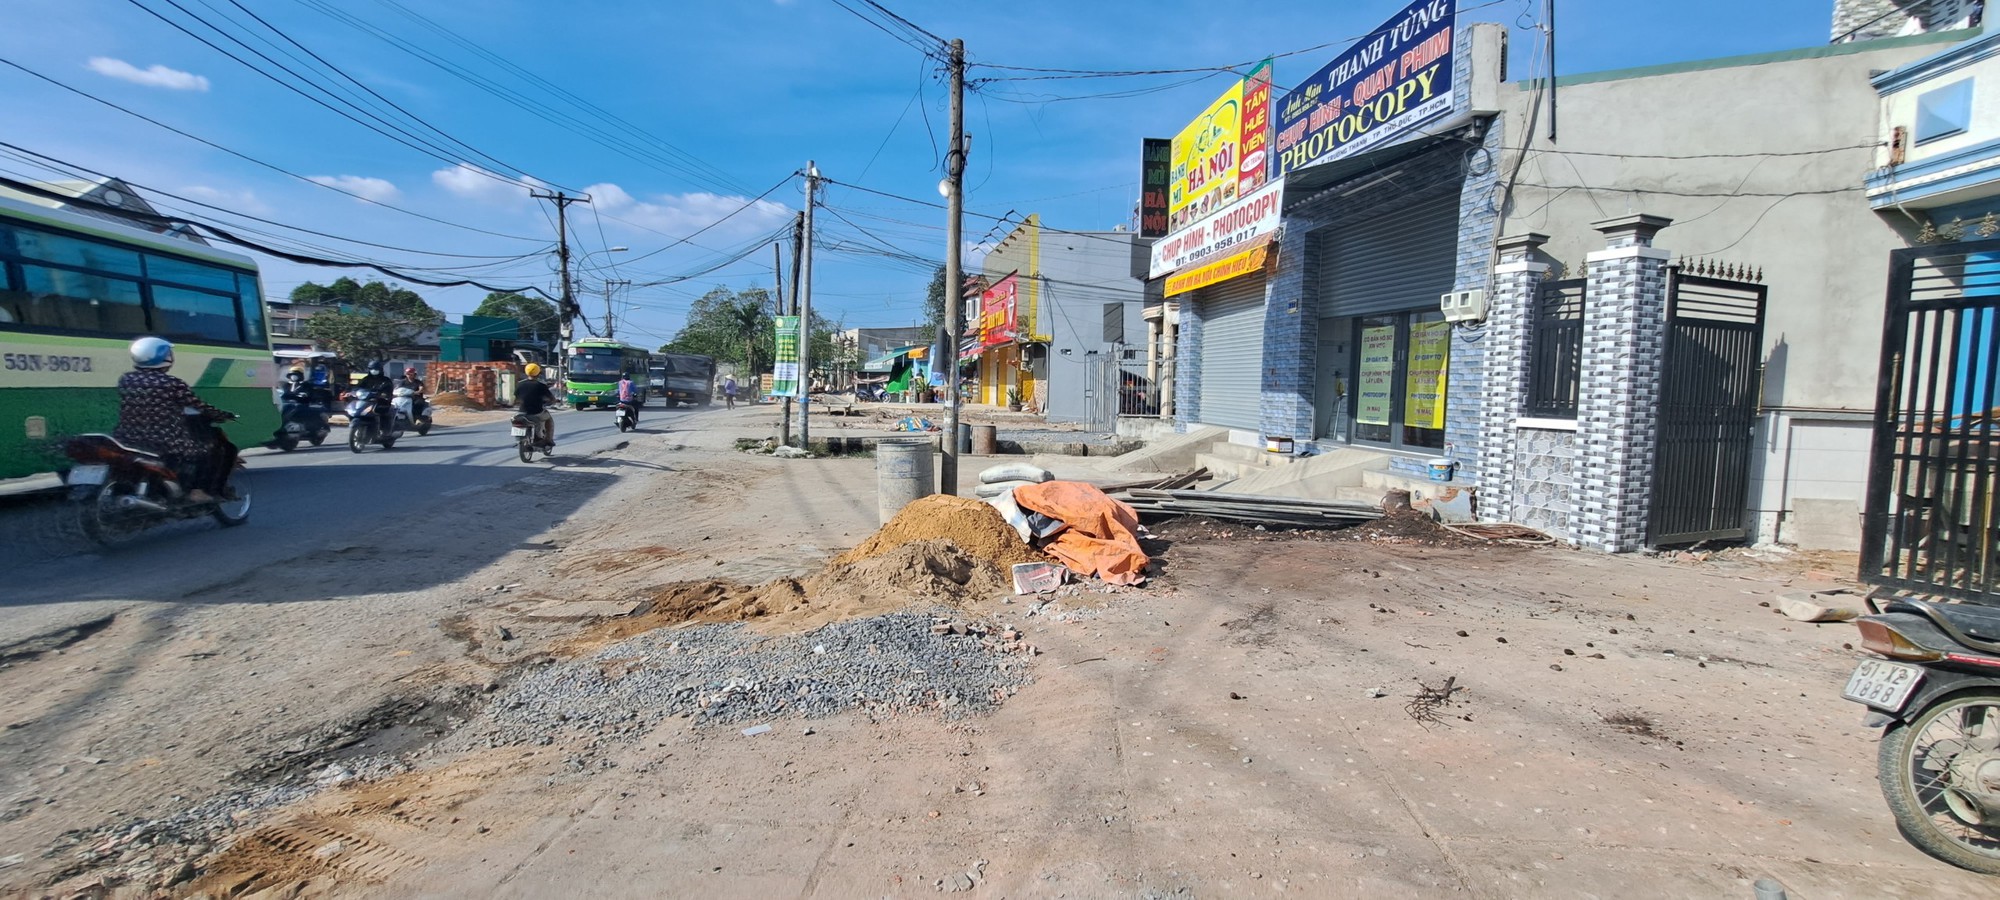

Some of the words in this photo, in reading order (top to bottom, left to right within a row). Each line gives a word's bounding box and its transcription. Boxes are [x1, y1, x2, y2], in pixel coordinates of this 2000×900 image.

[1328, 34, 1387, 93] THANH
[1390, 0, 1448, 51] TÙNG
[1309, 94, 1342, 134] HÌNH
[1353, 59, 1397, 106] QUAY
[1400, 26, 1450, 79] PHIM
[1245, 87, 1267, 114] TÂN
[1419, 98, 1447, 116] TP.HCM
[1279, 63, 1441, 177] PHOTOCOPY
[1209, 141, 1234, 178] NỘI
[1144, 188, 1166, 208] HÀ
[1213, 189, 1280, 240] PHOTOCOPY
[1143, 210, 1167, 234] NỘI
[1189, 226, 1258, 261] 0903.958.017
[1851, 679, 1895, 703] 1888
